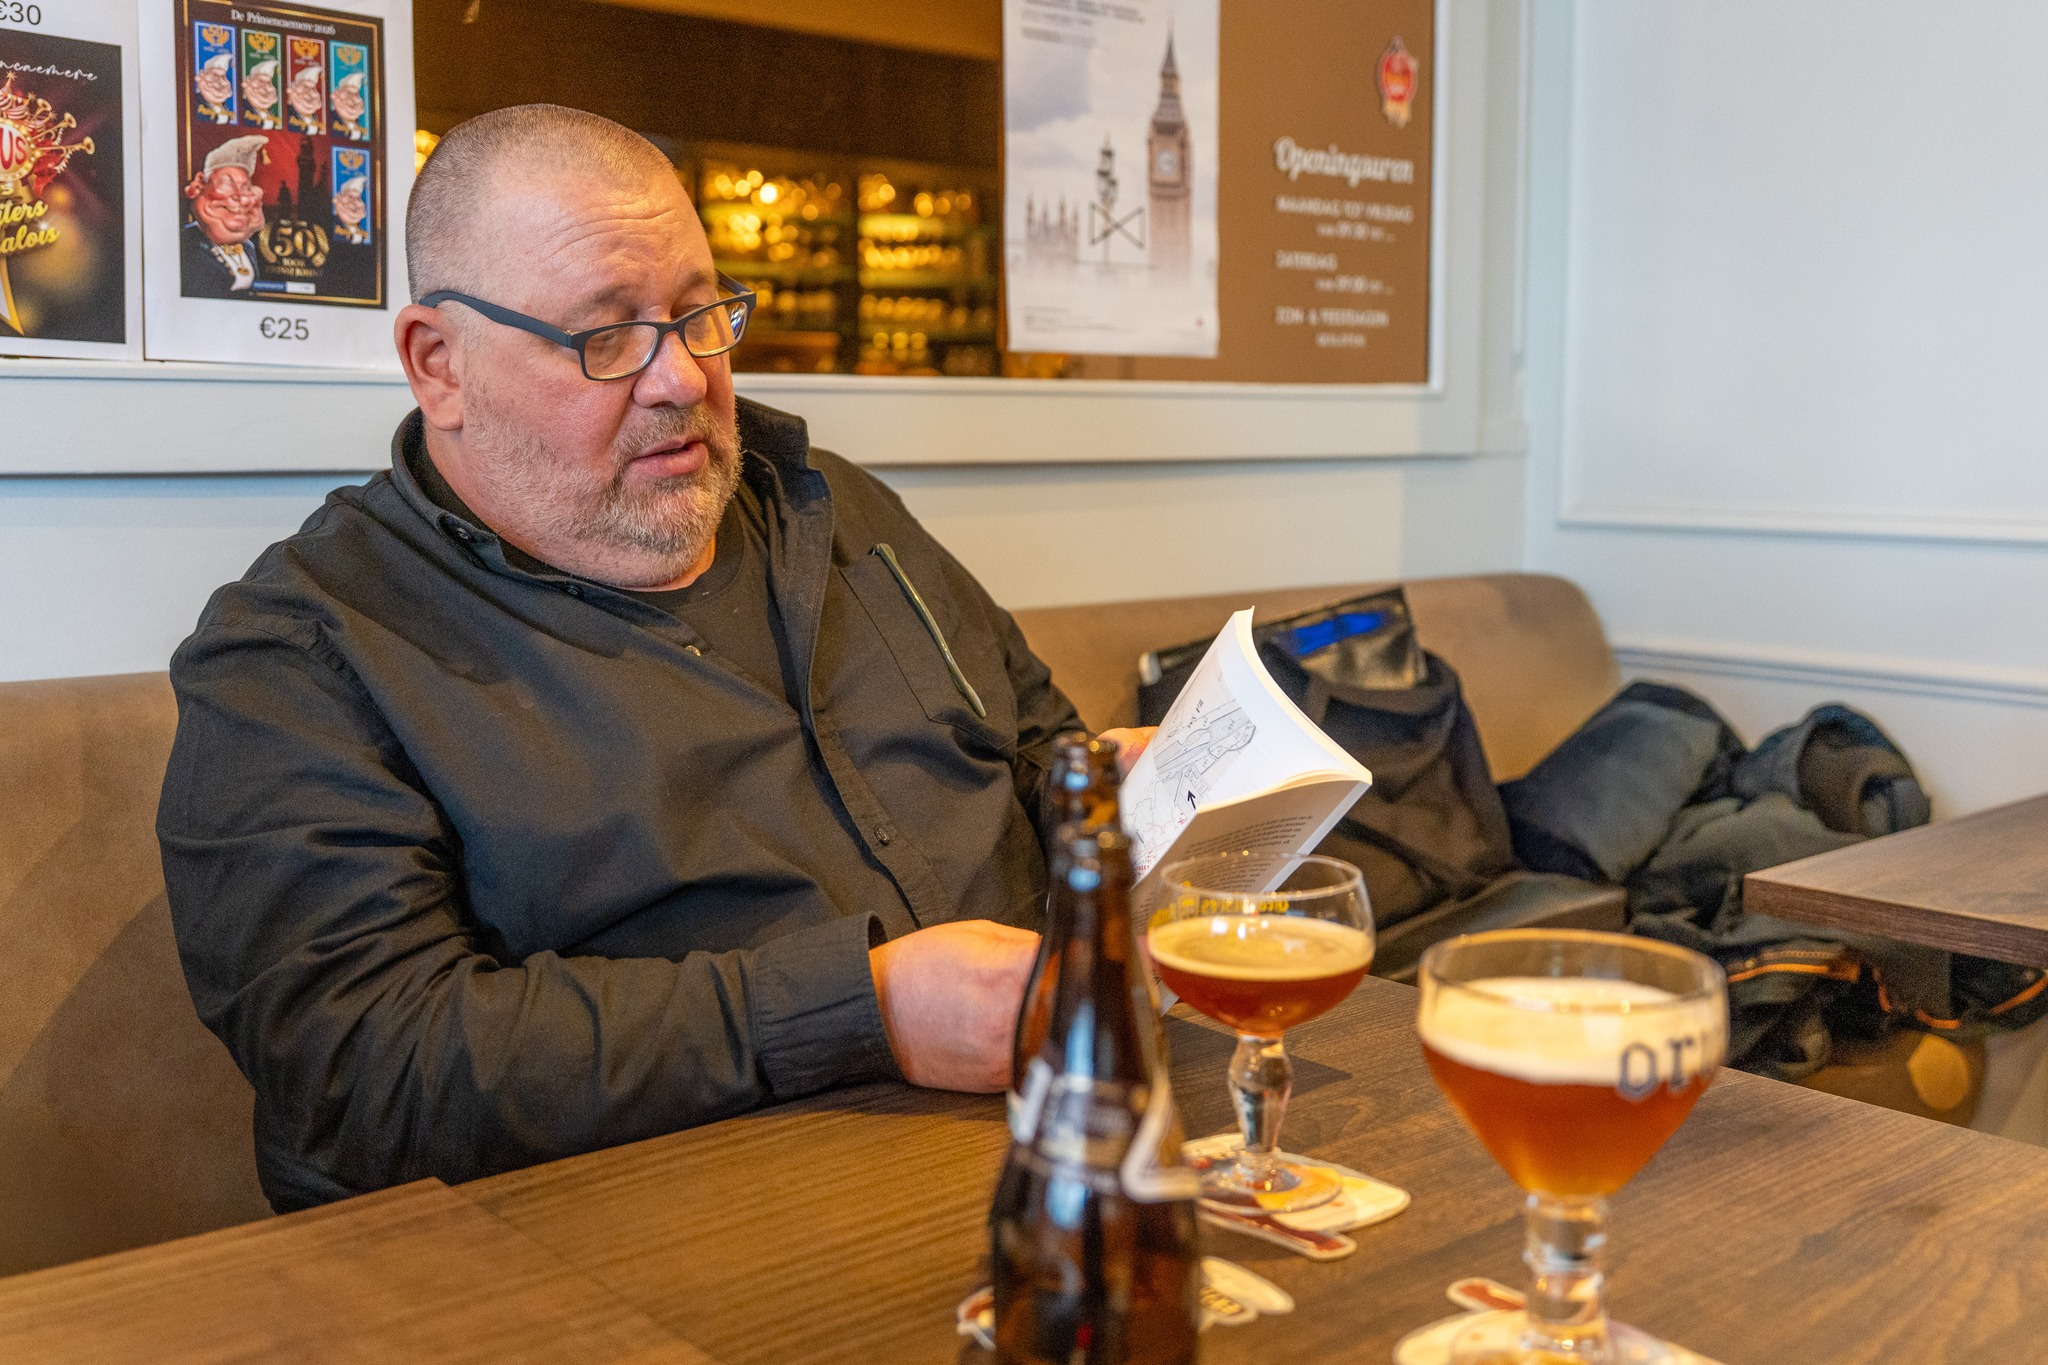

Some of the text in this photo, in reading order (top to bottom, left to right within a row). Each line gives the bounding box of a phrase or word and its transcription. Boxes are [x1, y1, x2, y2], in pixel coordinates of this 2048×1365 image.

[231, 8, 245, 21] De
[274, 227, 316, 258] 50
[259, 316, 310, 341] €25
